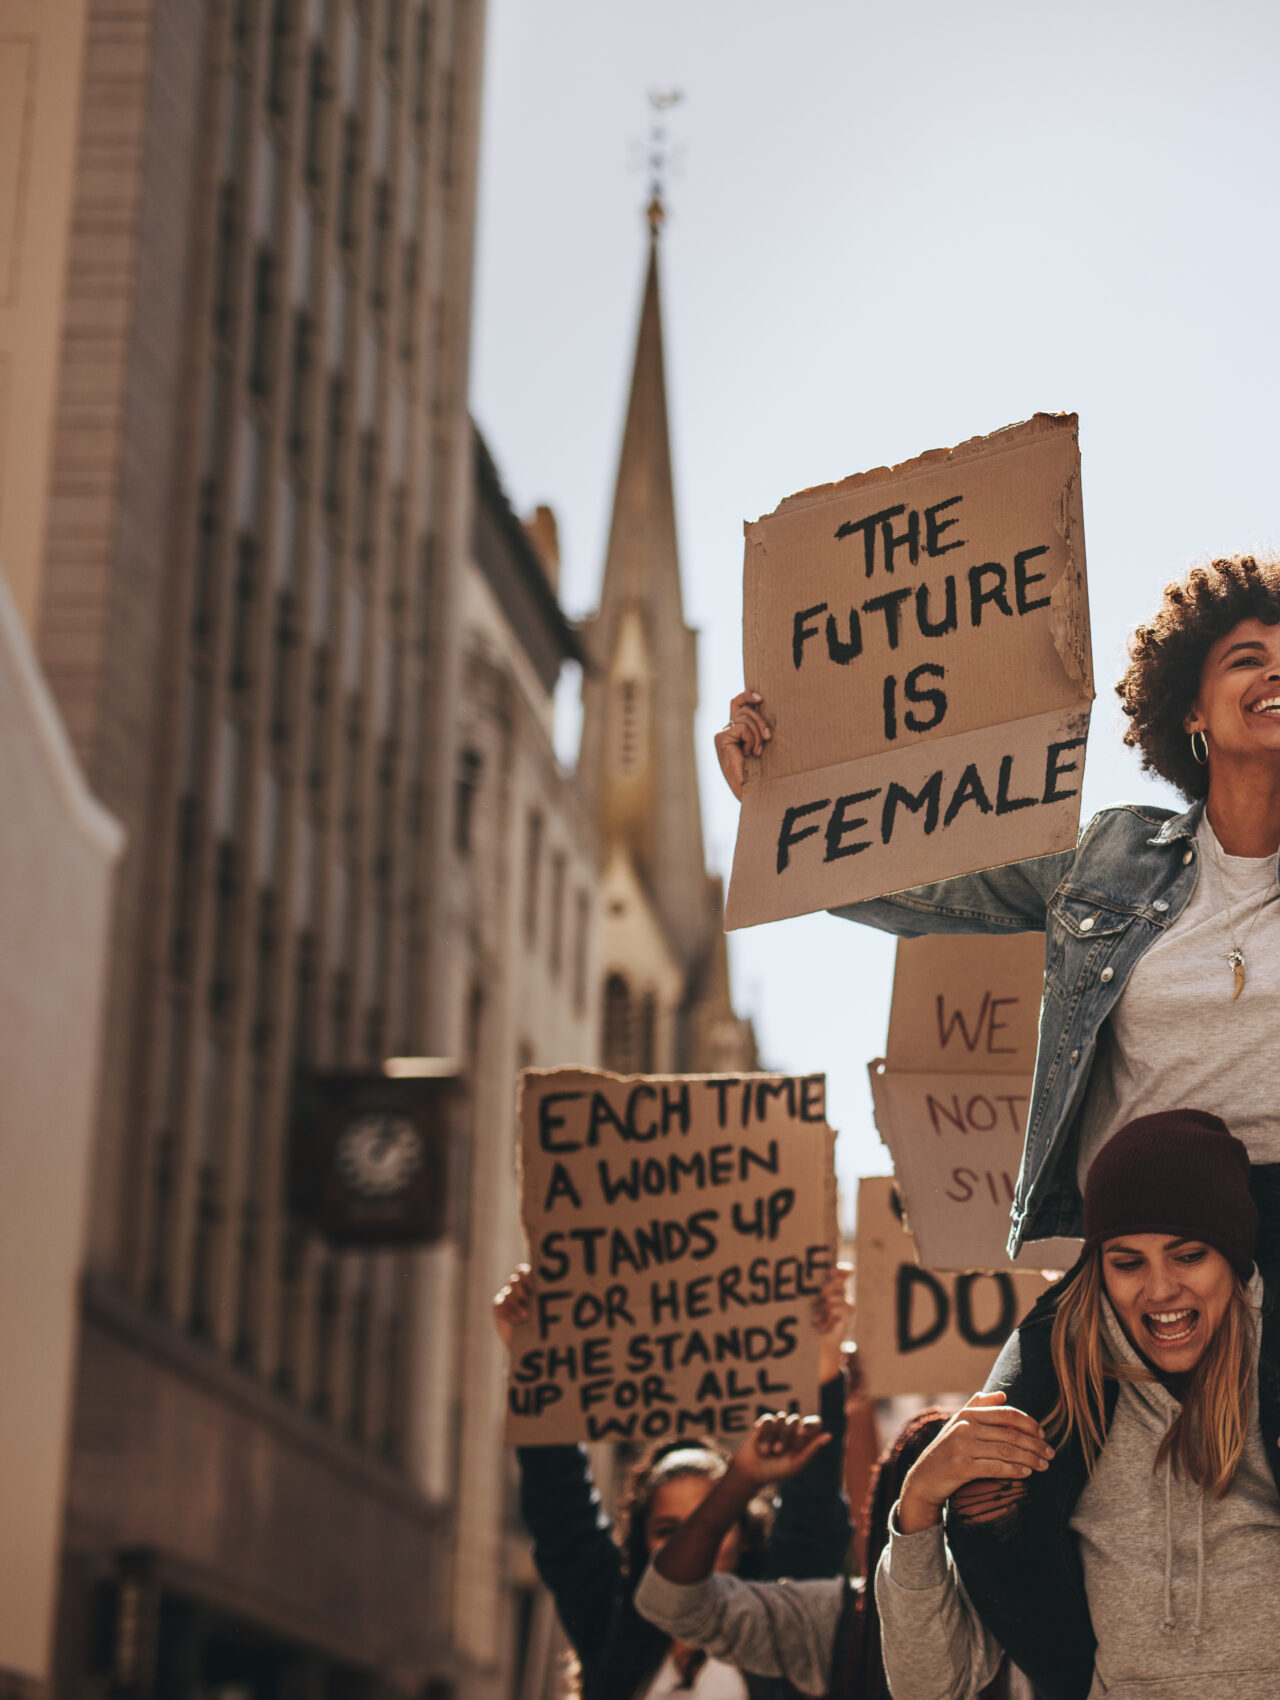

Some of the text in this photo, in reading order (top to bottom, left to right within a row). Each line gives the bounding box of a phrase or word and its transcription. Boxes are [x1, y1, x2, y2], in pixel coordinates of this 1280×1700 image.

[834, 495, 968, 579] THE
[791, 544, 1053, 671] FUTURE
[882, 661, 949, 741] IS
[775, 736, 1088, 876] FEMALE
[935, 990, 1020, 1055] WE
[536, 1077, 827, 1156] EACH TIME
[924, 1093, 1027, 1136] NOT
[543, 1139, 779, 1214] A WOMEN
[536, 1208, 721, 1284] STANDS
[536, 1244, 832, 1342] FOR HERSELF
[512, 1315, 800, 1386] SHE STANDS
[578, 1373, 679, 1412] FOR
[693, 1366, 792, 1403] ALL
